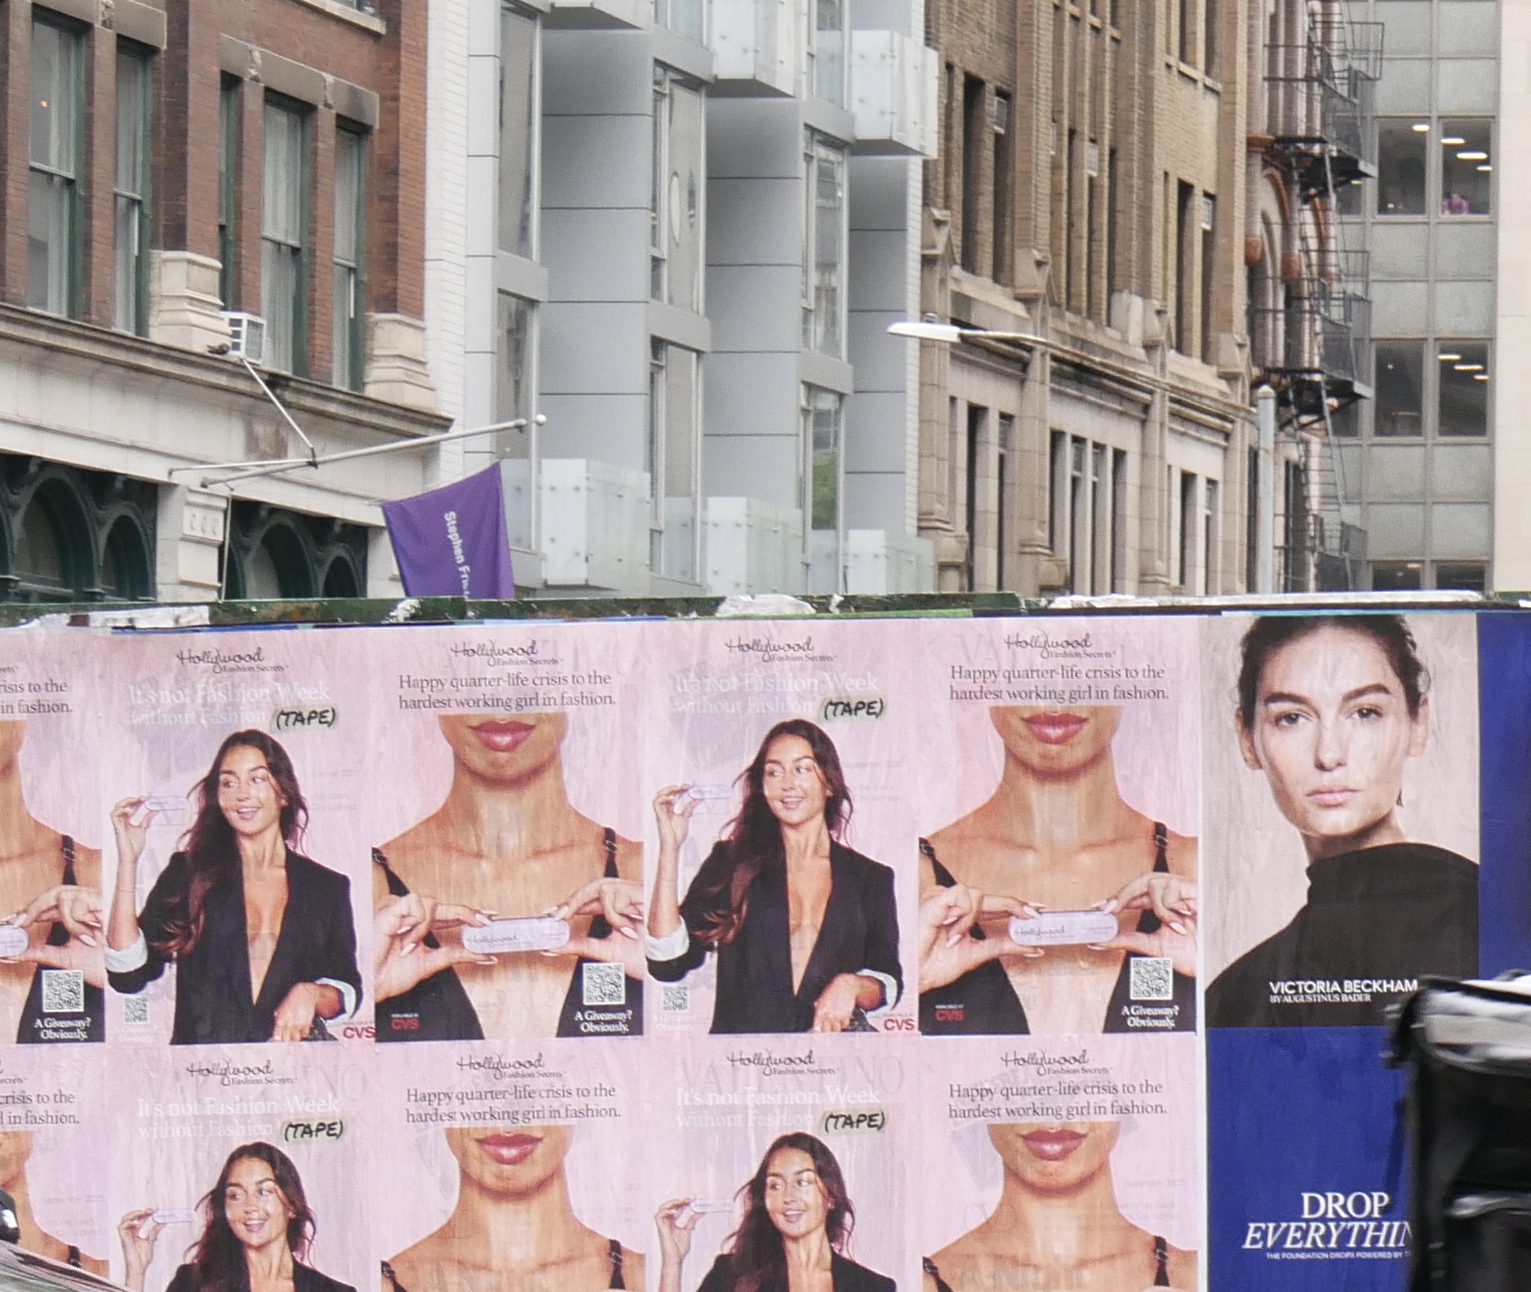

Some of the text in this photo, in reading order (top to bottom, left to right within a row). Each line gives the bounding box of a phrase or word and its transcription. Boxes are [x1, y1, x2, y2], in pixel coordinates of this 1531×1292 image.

[444, 511, 465, 564] Stephen
[451, 639, 538, 667] Hollywood
[725, 635, 816, 663] Hollywood
[1004, 632, 1092, 659] Hollywood
[177, 647, 265, 674] Hollywood
[399, 670, 612, 693] Happy quarter-life crisis to the
[951, 664, 1165, 683] Happy quarter-life crisis to the
[28, 680, 68, 693] to the
[950, 684, 1170, 704] hardest working girl in fashion.
[17, 700, 73, 714] fashion.
[398, 690, 616, 711] hardest working girl in fashion.
[823, 698, 884, 720] (TAPE)
[276, 707, 337, 730] (TAPE)
[1269, 978, 1418, 994] VICTORIA BECKHAM
[343, 1026, 377, 1039] CVS
[884, 1019, 915, 1031] CVS
[187, 1059, 273, 1086] Hollywood
[456, 1053, 545, 1080] Hollywood
[727, 1049, 816, 1077] Hollywood
[1000, 1049, 1089, 1076] Hollywood
[37, 1090, 75, 1104] to the
[406, 1083, 616, 1106] Happy quarter-life crisis to the
[949, 1079, 1163, 1101] Happy quarter-life crisis to the
[8, 1110, 80, 1125] in fashion.
[406, 1104, 621, 1124] hardest working girl in fashion.
[824, 1110, 886, 1133] (TAPE)
[948, 1101, 1167, 1120] hardest working girl in fashion.
[284, 1120, 344, 1141] (TAPE)
[1301, 1191, 1391, 1219] DROP
[1242, 1221, 1413, 1250] EVERYTHIN
[1266, 1252, 1280, 1260] THE
[1356, 1251, 1392, 1259] POWERED
